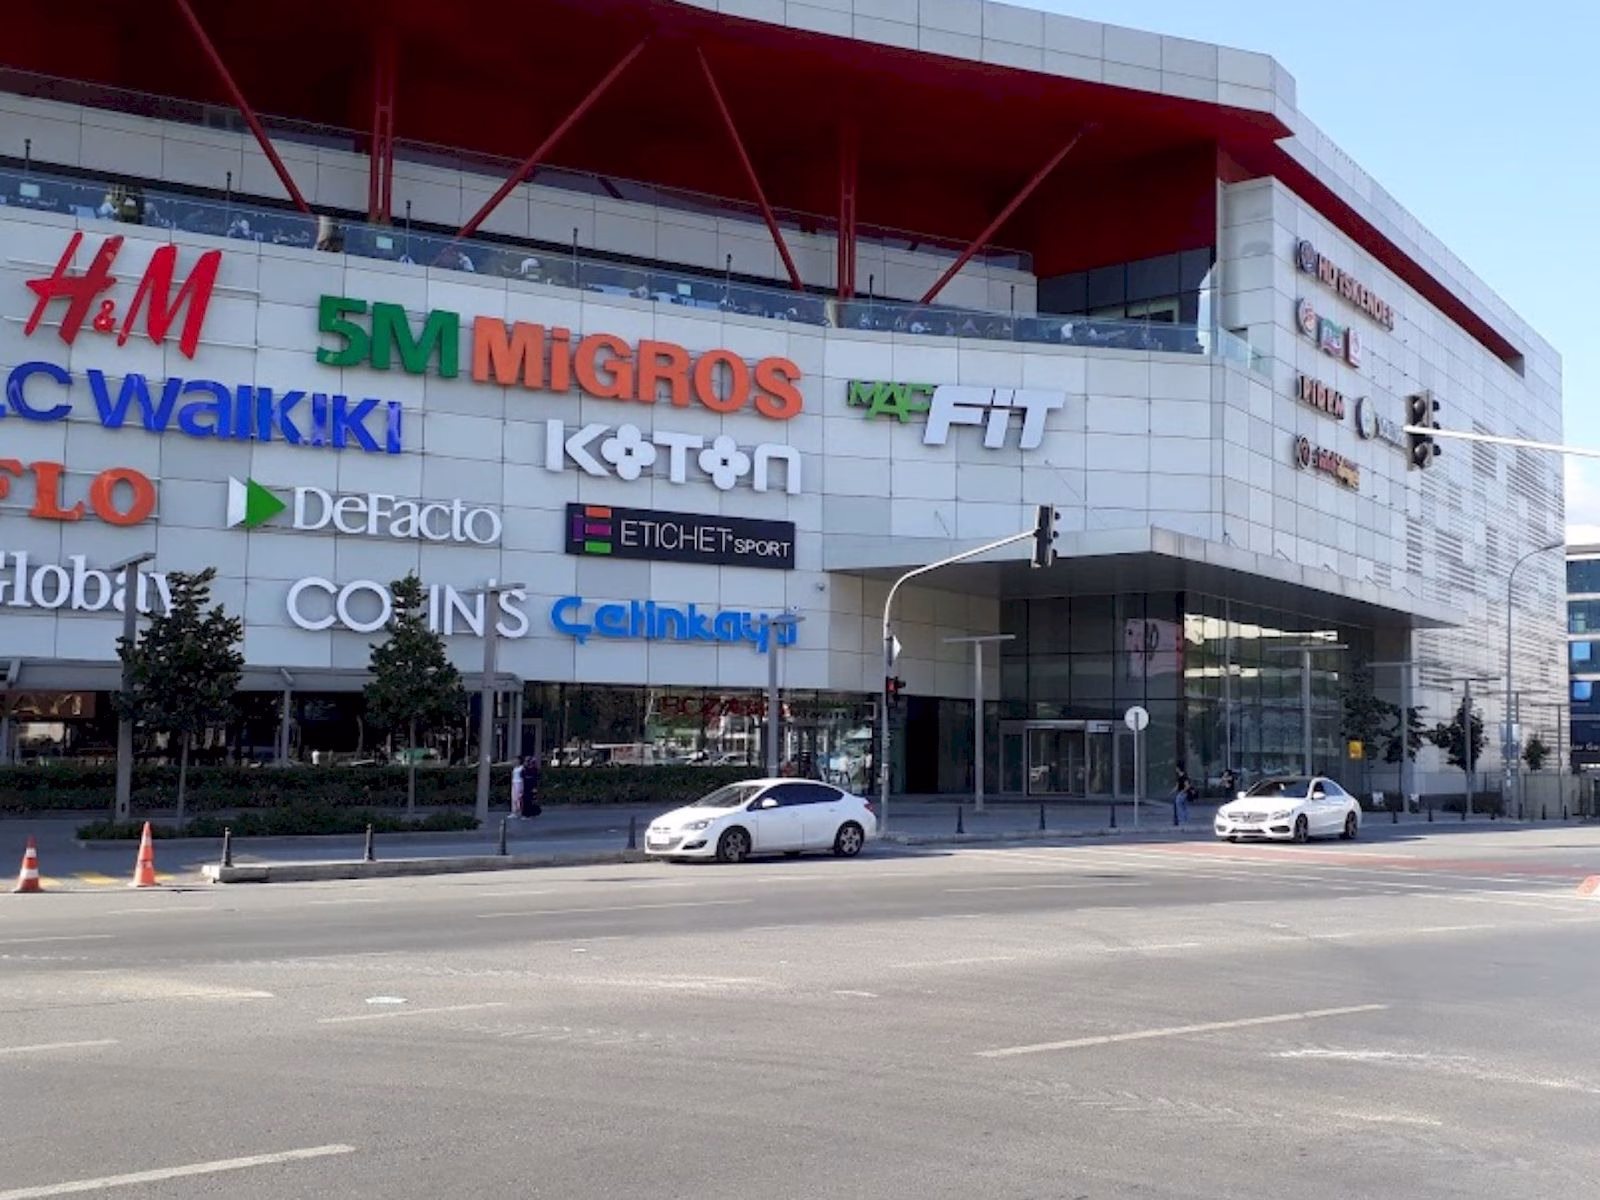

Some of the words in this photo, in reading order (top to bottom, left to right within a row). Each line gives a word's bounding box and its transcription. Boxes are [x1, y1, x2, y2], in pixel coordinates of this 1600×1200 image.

[24, 231, 222, 360] H&M
[316, 294, 460, 378] 5M
[0, 361, 73, 421] C
[620, 520, 732, 553] ETICHET
[733, 538, 791, 557] SPORT
[286, 576, 529, 639] COIN'S
